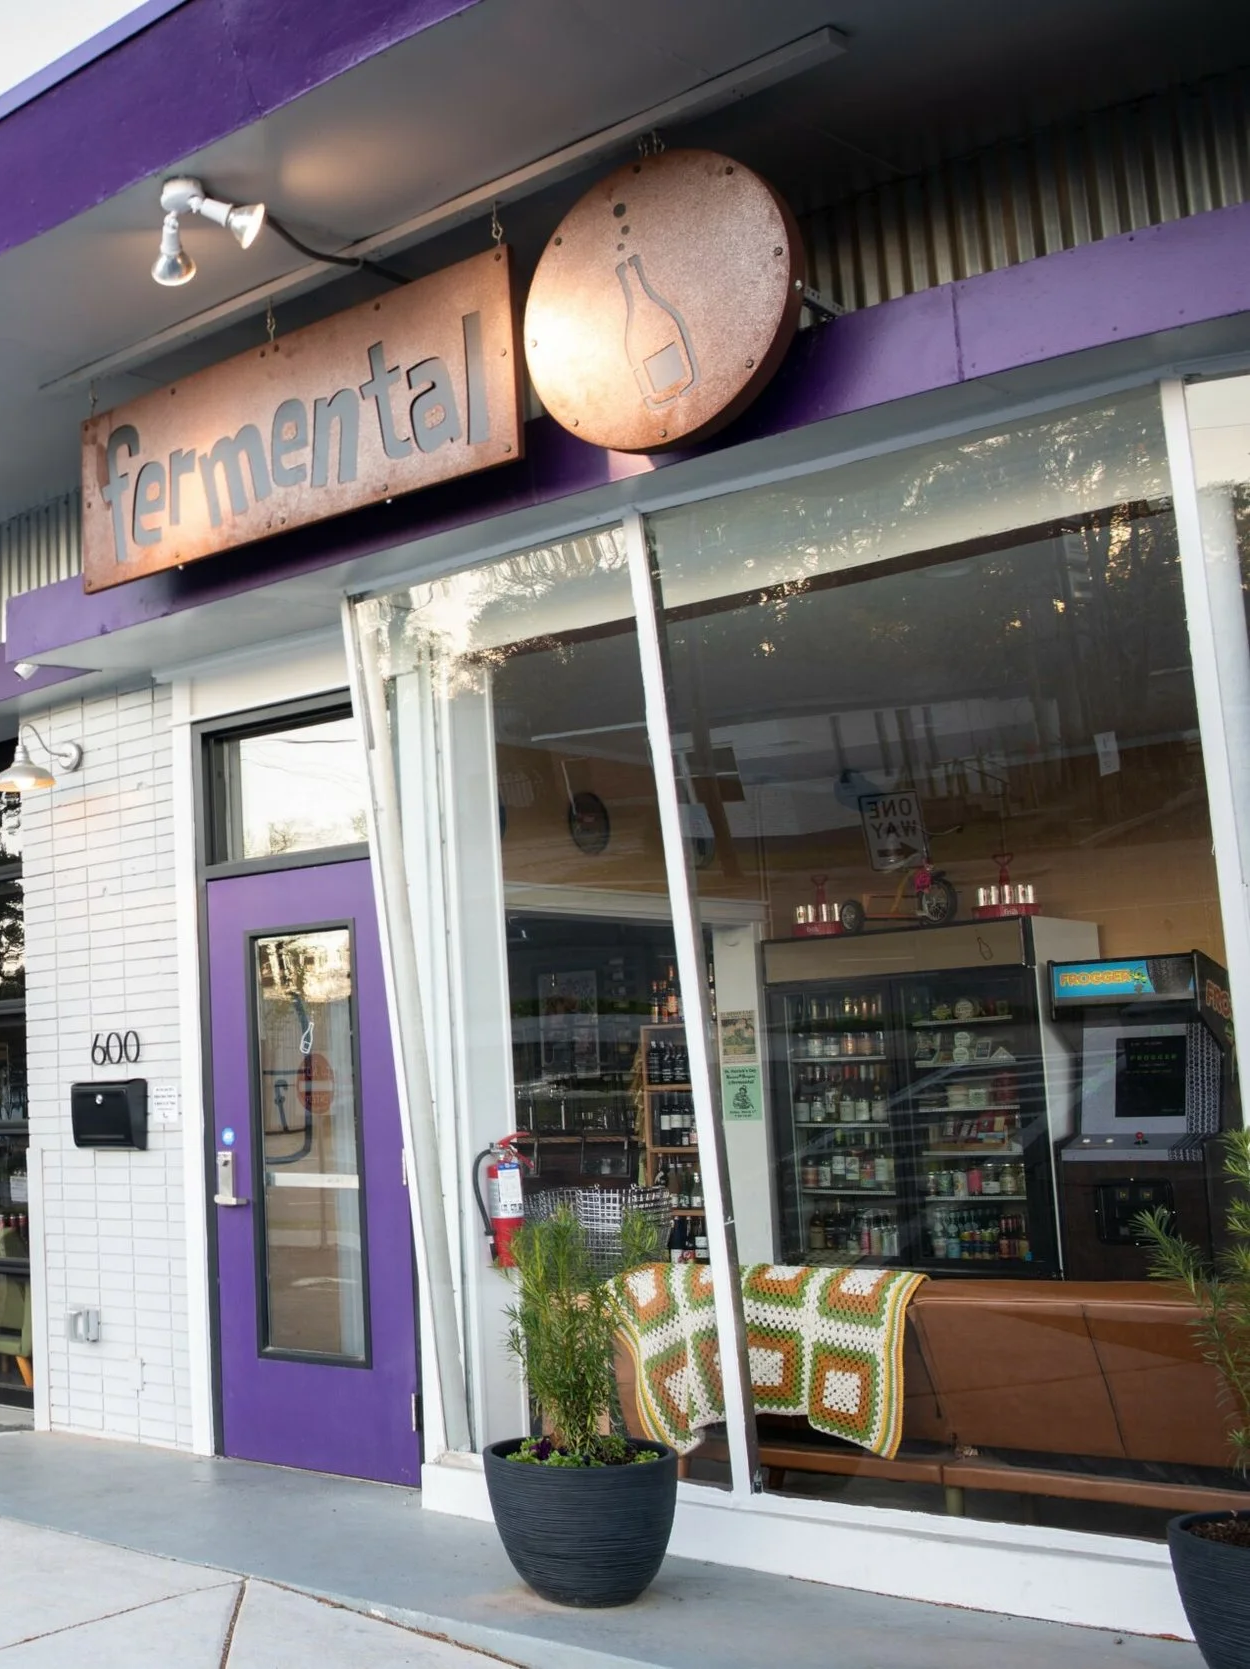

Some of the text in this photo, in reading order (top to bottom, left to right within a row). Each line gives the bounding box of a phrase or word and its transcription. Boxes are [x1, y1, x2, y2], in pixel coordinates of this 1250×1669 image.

[101, 310, 489, 565] fermental
[1059, 969, 1132, 987] FROGGER
[91, 1030, 140, 1066] 600
